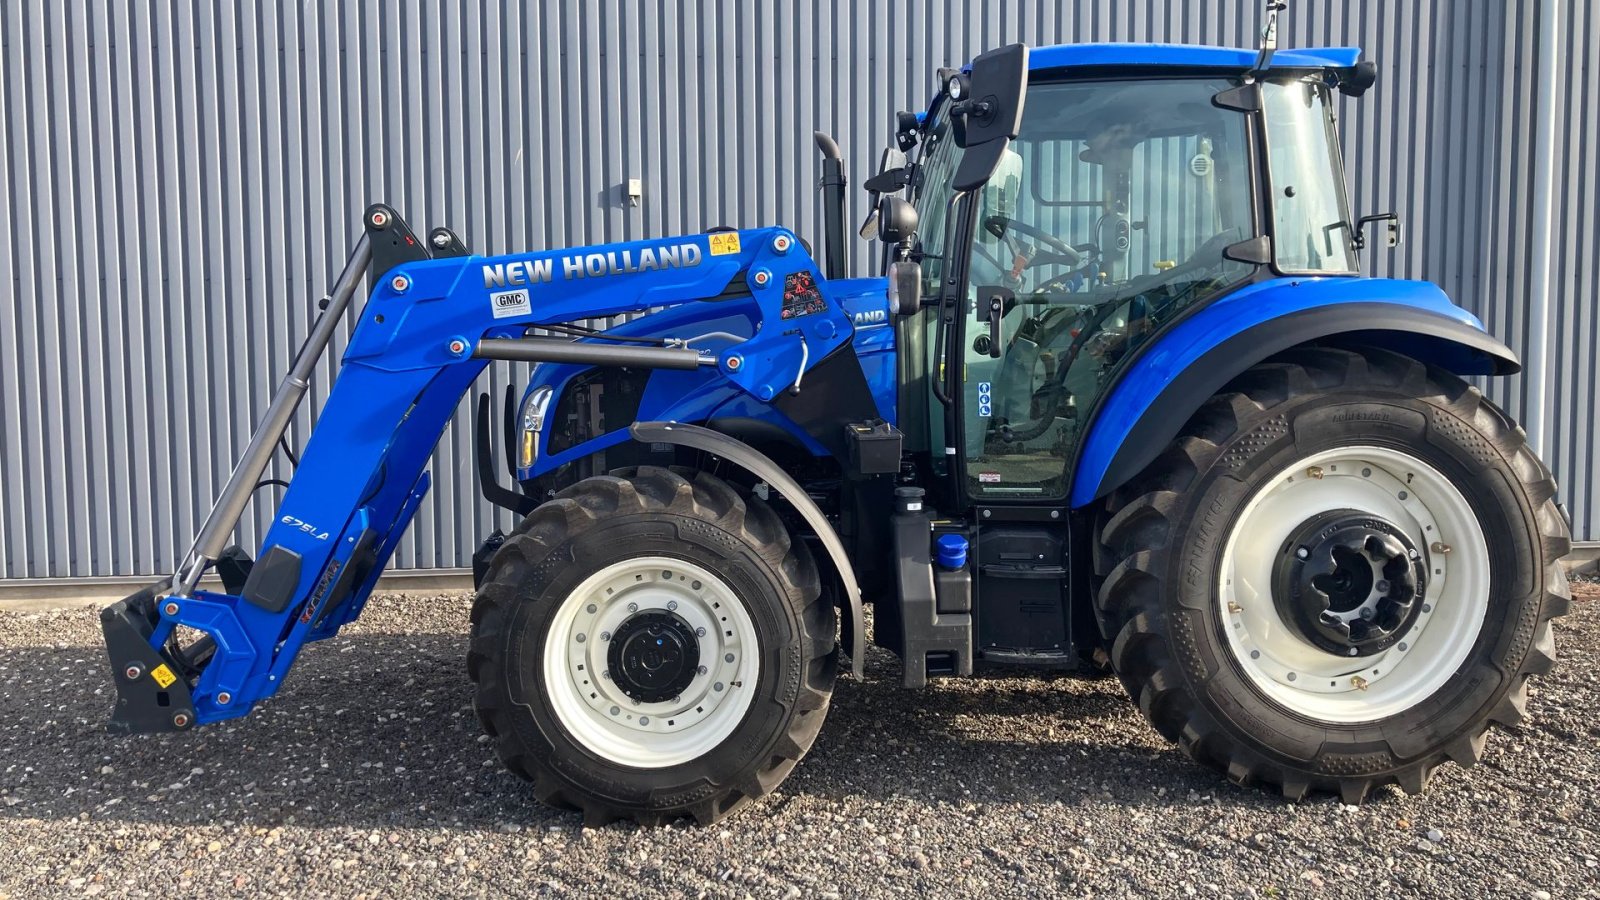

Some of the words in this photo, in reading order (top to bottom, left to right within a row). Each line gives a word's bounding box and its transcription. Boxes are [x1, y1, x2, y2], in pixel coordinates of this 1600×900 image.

[482, 258, 553, 289] NEW
[562, 243, 702, 280] HOLLAND
[499, 294, 522, 306] GMC
[281, 515, 329, 541] E75LA
